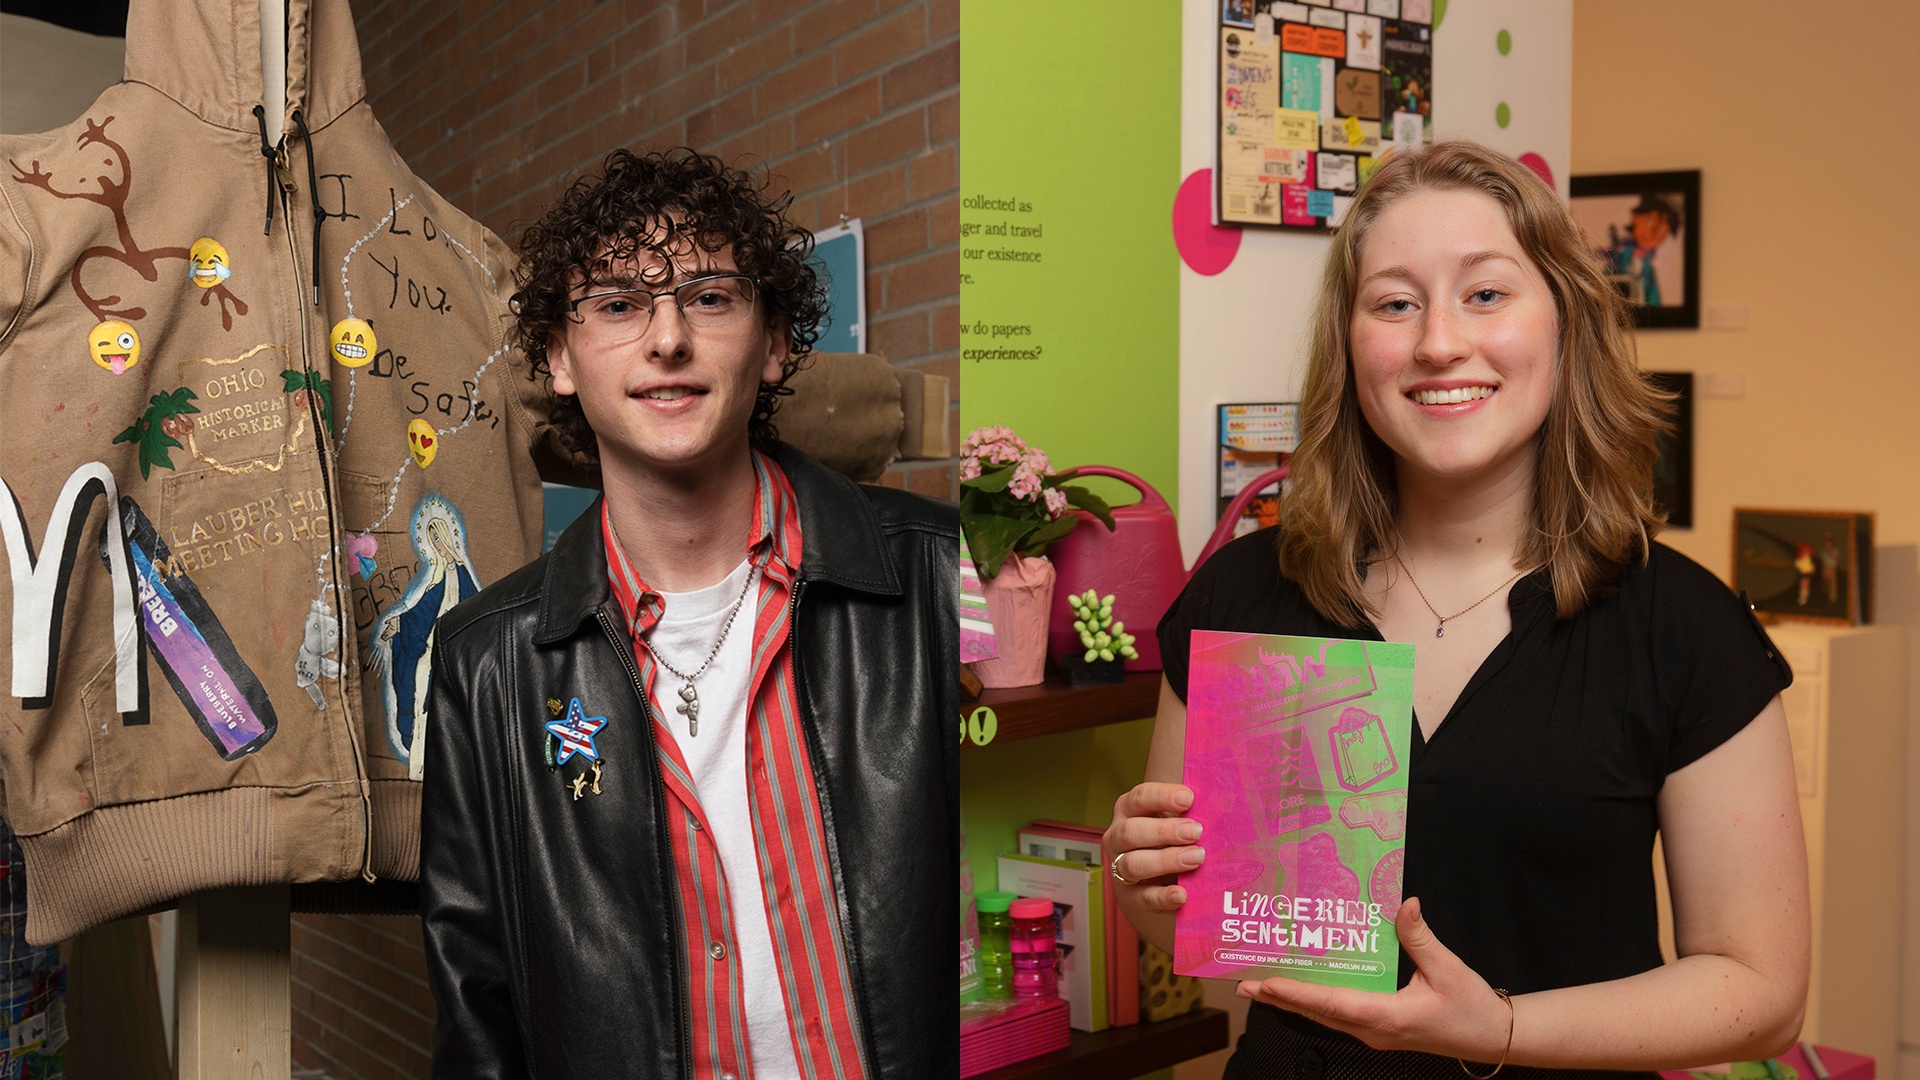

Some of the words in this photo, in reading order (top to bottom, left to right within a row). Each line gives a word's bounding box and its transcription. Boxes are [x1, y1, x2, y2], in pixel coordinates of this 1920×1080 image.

[963, 195, 1016, 212] collected
[1019, 201, 1033, 213] as
[985, 222, 1007, 237] and
[1011, 224, 1043, 238] travel
[963, 248, 984, 260] our
[988, 247, 1042, 262] existence
[973, 320, 989, 335] do
[992, 324, 1032, 338] papers
[963, 346, 1043, 362] experiences?
[205, 368, 267, 399] OHIO
[211, 415, 286, 442] MARKER
[170, 496, 283, 548] LAUBER
[153, 521, 284, 583] MEETING
[199, 680, 238, 730] BLUEBERRY
[1220, 952, 1256, 962] EXISTENCE
[1267, 956, 1279, 964] INK
[1279, 957, 1294, 965] AND
[1294, 959, 1313, 967] FIBER
[1329, 962, 1360, 971] MADELYN
[1361, 964, 1378, 972] JUNK
